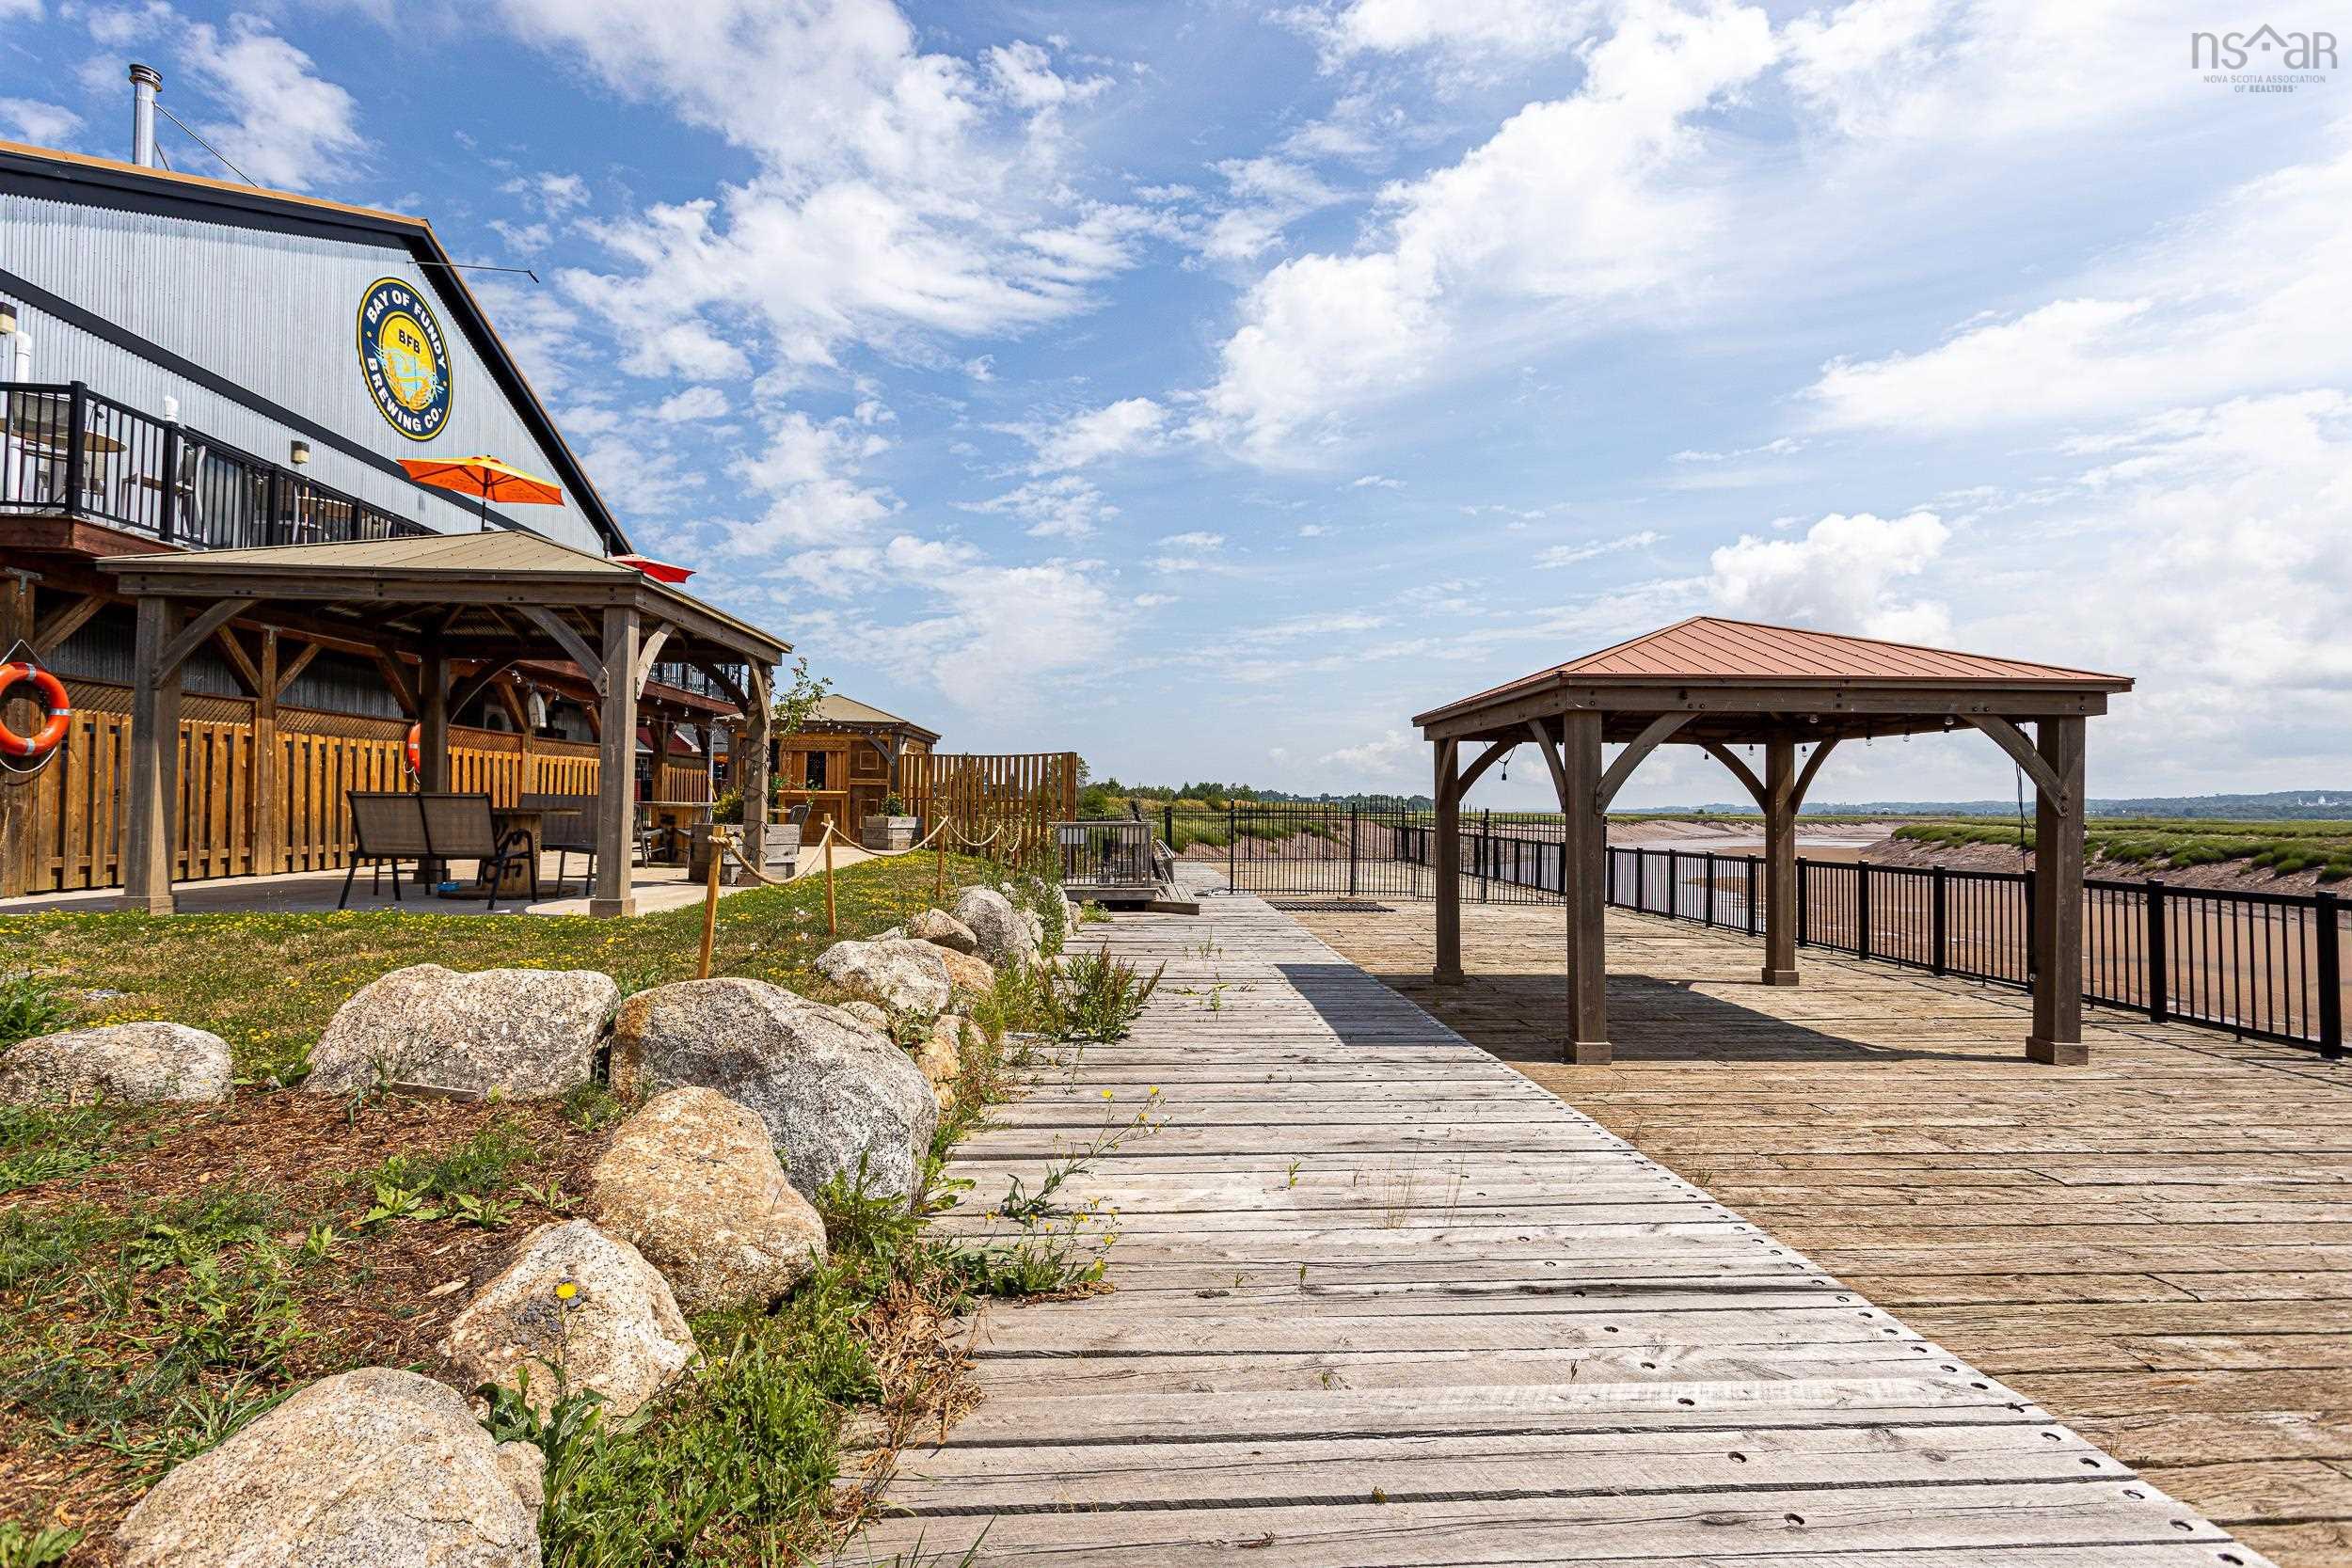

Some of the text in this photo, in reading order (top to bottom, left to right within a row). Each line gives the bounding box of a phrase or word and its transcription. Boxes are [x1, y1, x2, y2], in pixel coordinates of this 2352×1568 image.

[366, 290, 448, 370] BAY OF FUNDY
[398, 328, 421, 354] BFB
[367, 356, 443, 432] BREWING CO.
